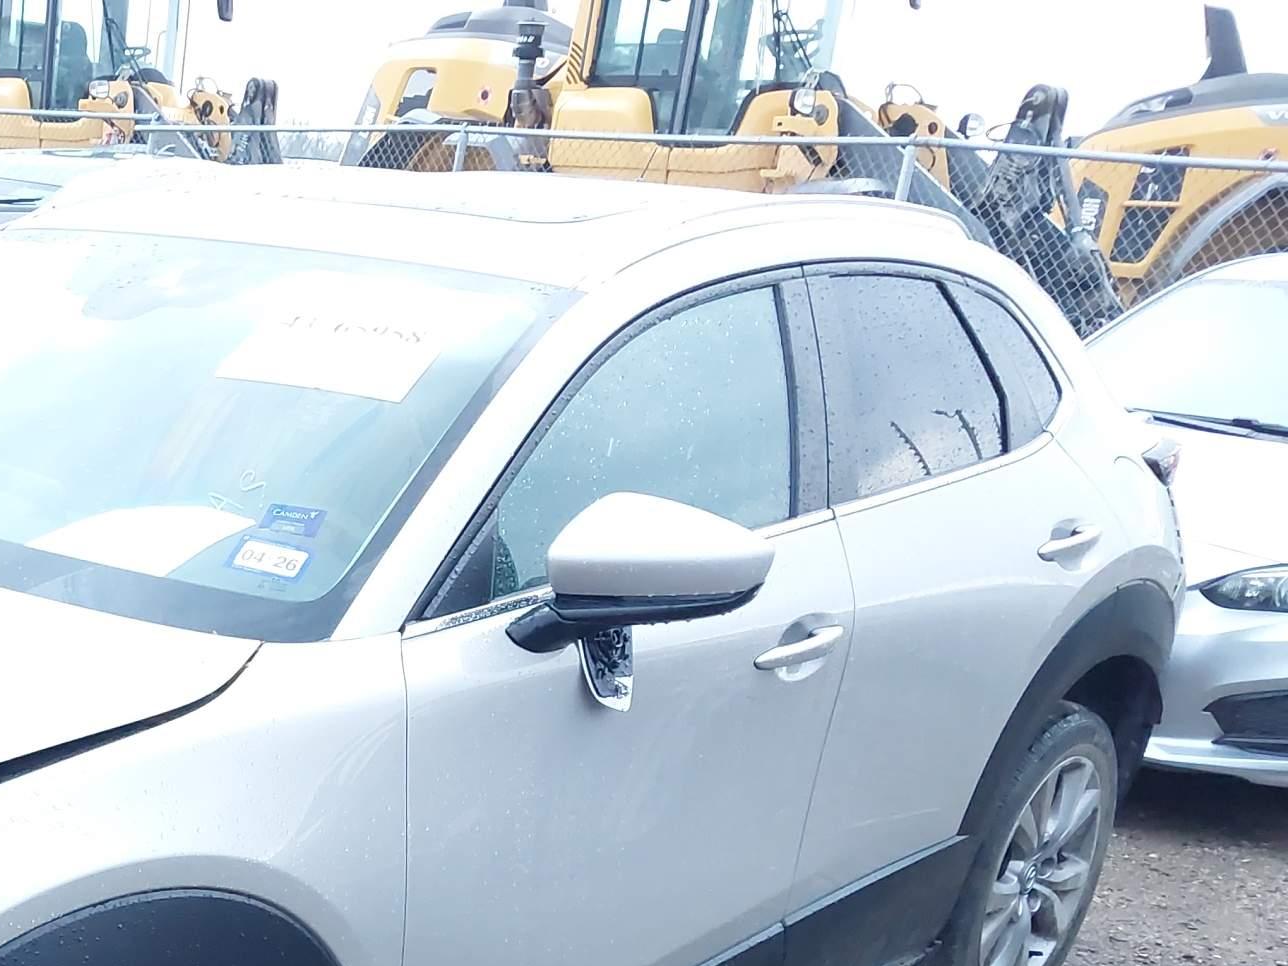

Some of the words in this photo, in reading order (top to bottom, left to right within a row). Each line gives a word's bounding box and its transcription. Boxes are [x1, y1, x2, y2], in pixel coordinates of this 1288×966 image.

[272, 508, 309, 519] CAMDEN
[241, 549, 266, 563] 04
[272, 555, 299, 571] 26
